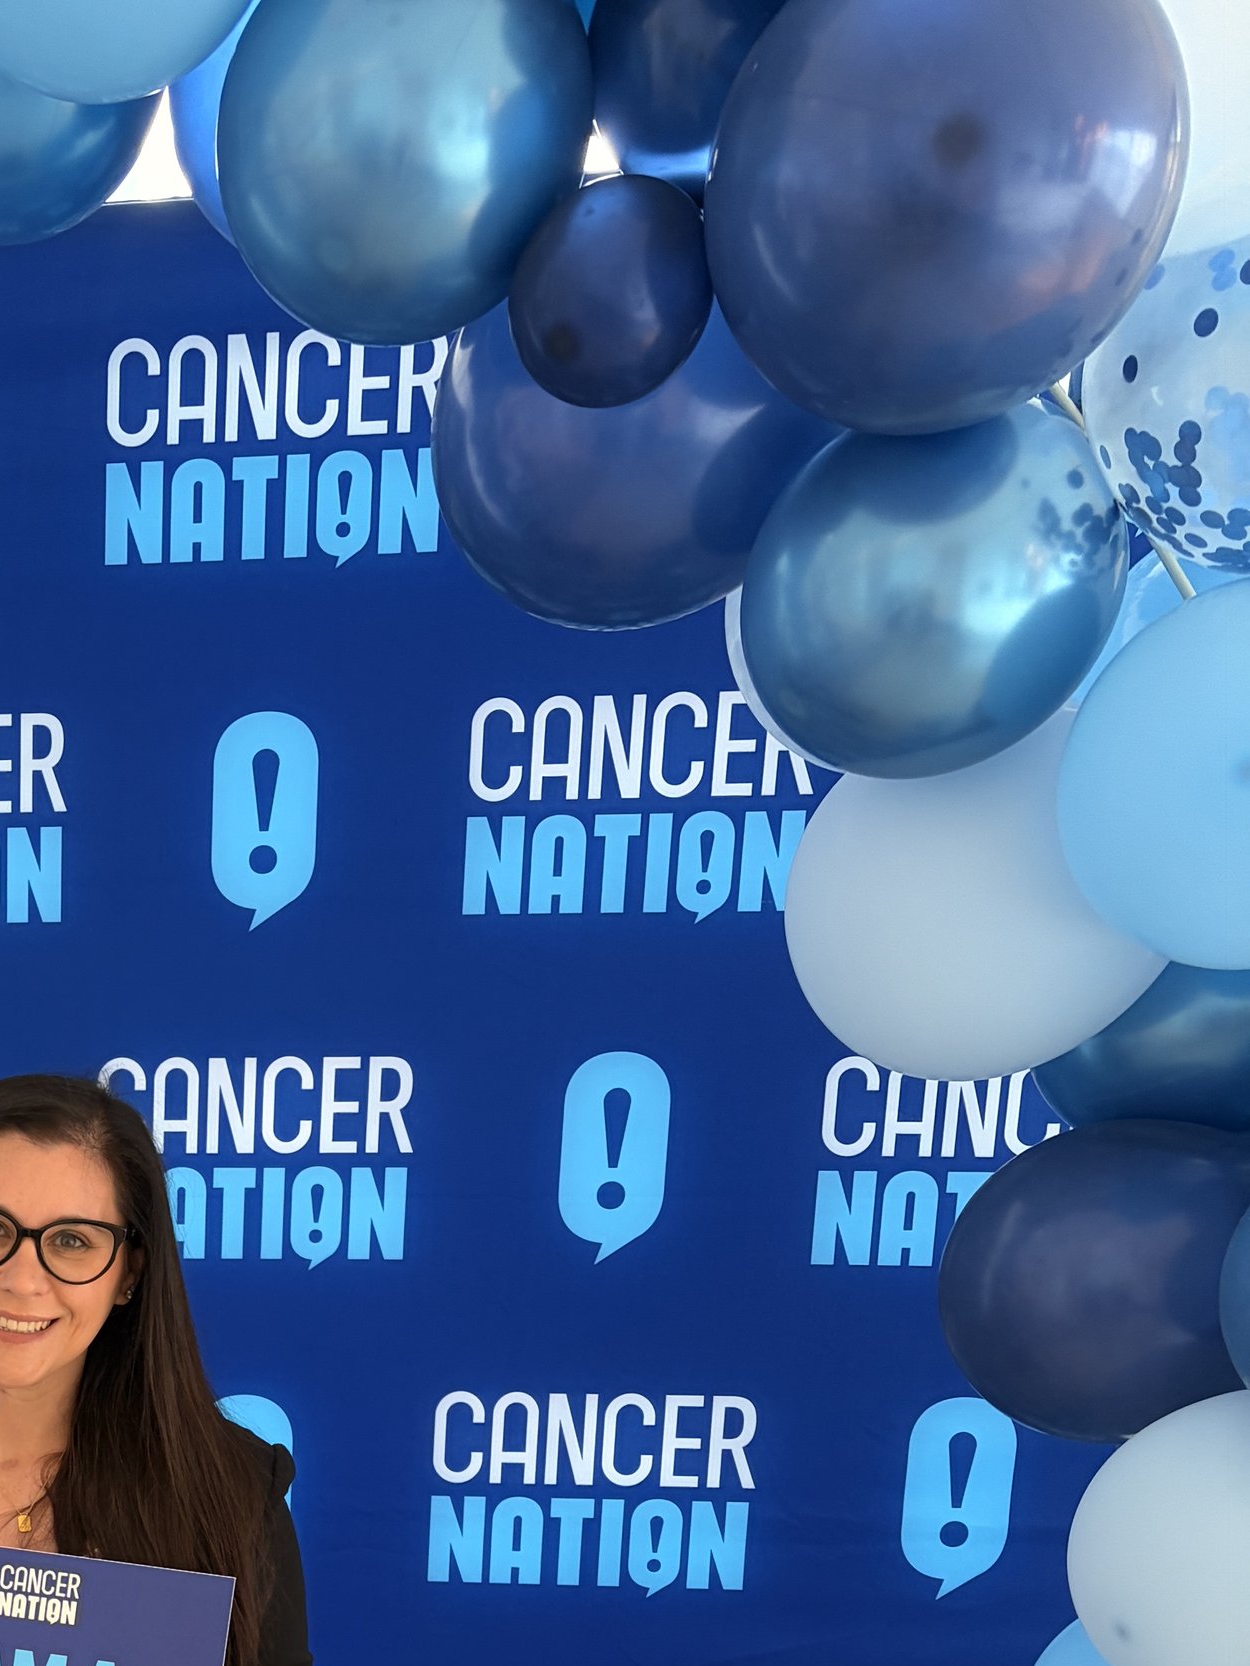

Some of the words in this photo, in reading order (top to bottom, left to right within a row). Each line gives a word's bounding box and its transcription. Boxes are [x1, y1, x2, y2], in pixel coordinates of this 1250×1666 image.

[106, 327, 449, 447] CANCER
[104, 448, 440, 569] NATION
[461, 810, 807, 924] NATION
[165, 1166, 408, 1271] ATION
[433, 1391, 757, 1490] CANCER
[0, 1564, 81, 1599] CANCER
[427, 1495, 750, 1598] NATION
